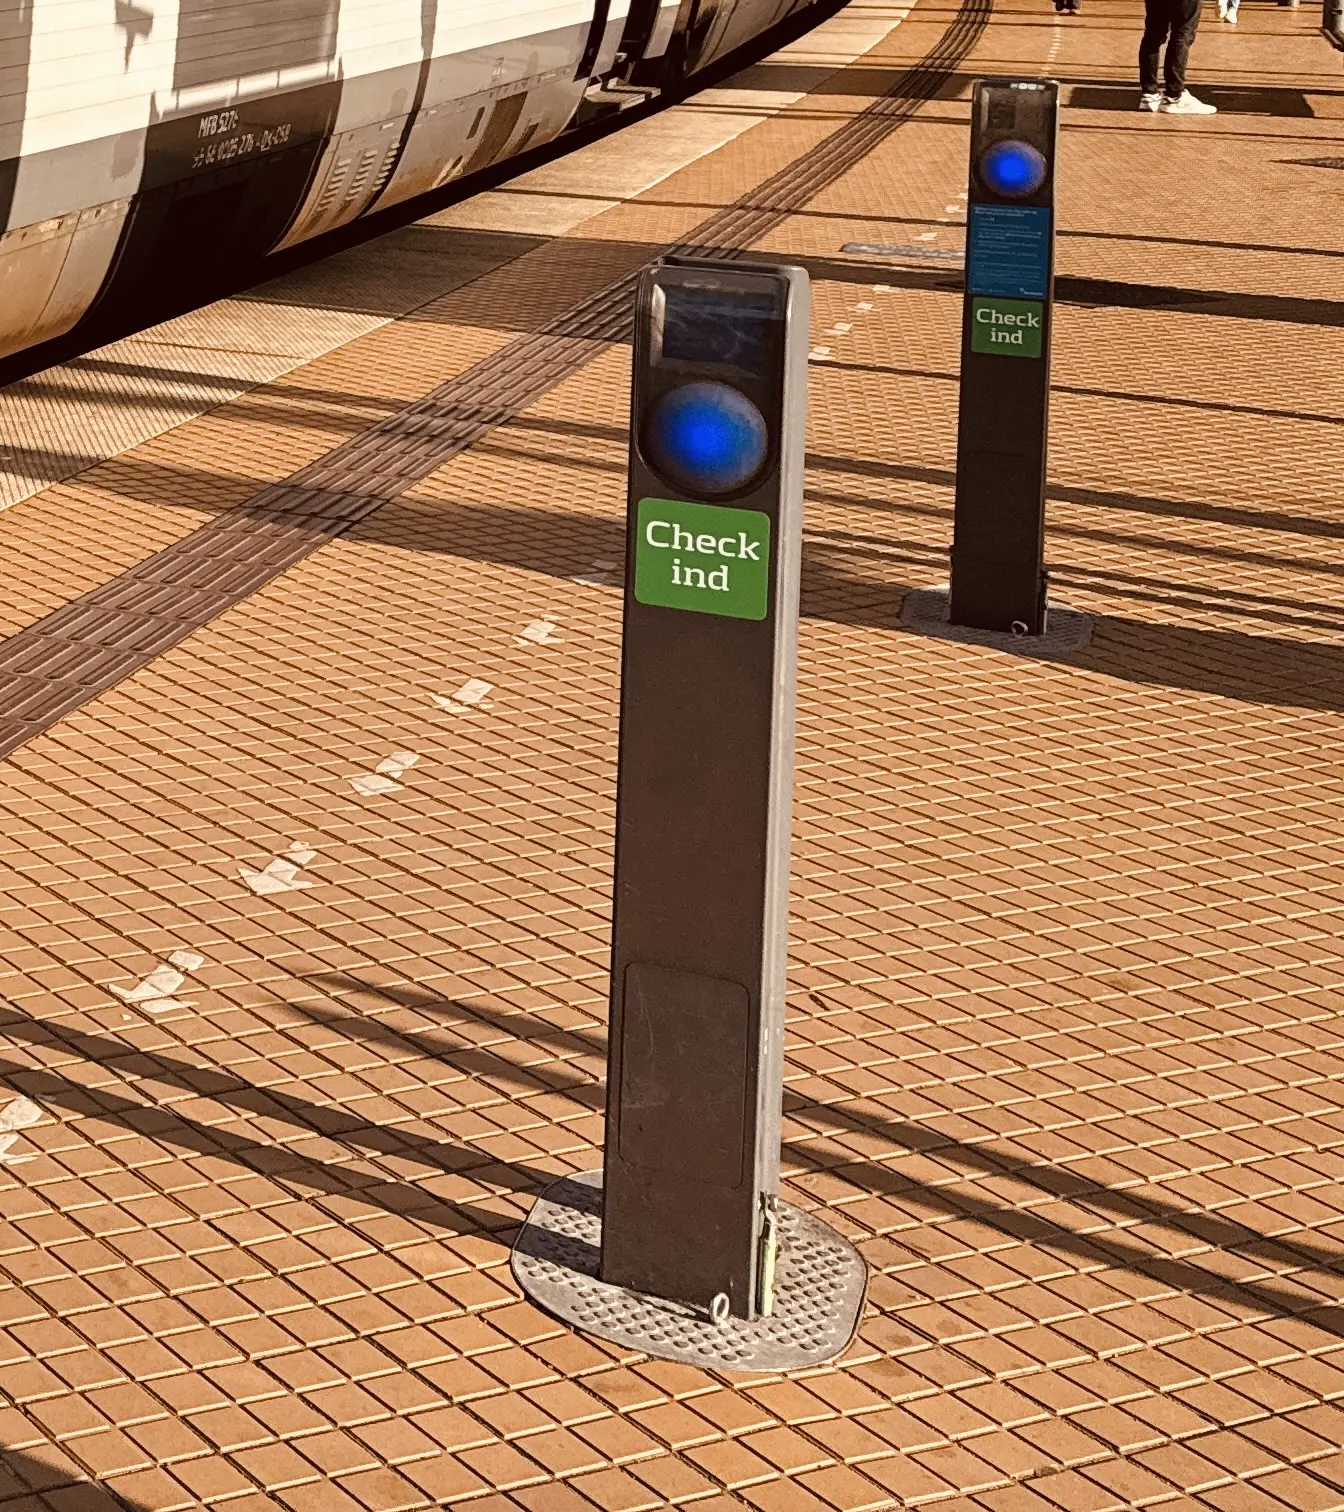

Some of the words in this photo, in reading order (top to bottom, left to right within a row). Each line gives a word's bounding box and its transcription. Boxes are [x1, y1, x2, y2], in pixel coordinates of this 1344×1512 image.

[975, 308, 1040, 329] Check
[991, 327, 1024, 345] ind
[646, 520, 760, 561] Check
[671, 558, 730, 592] ind
